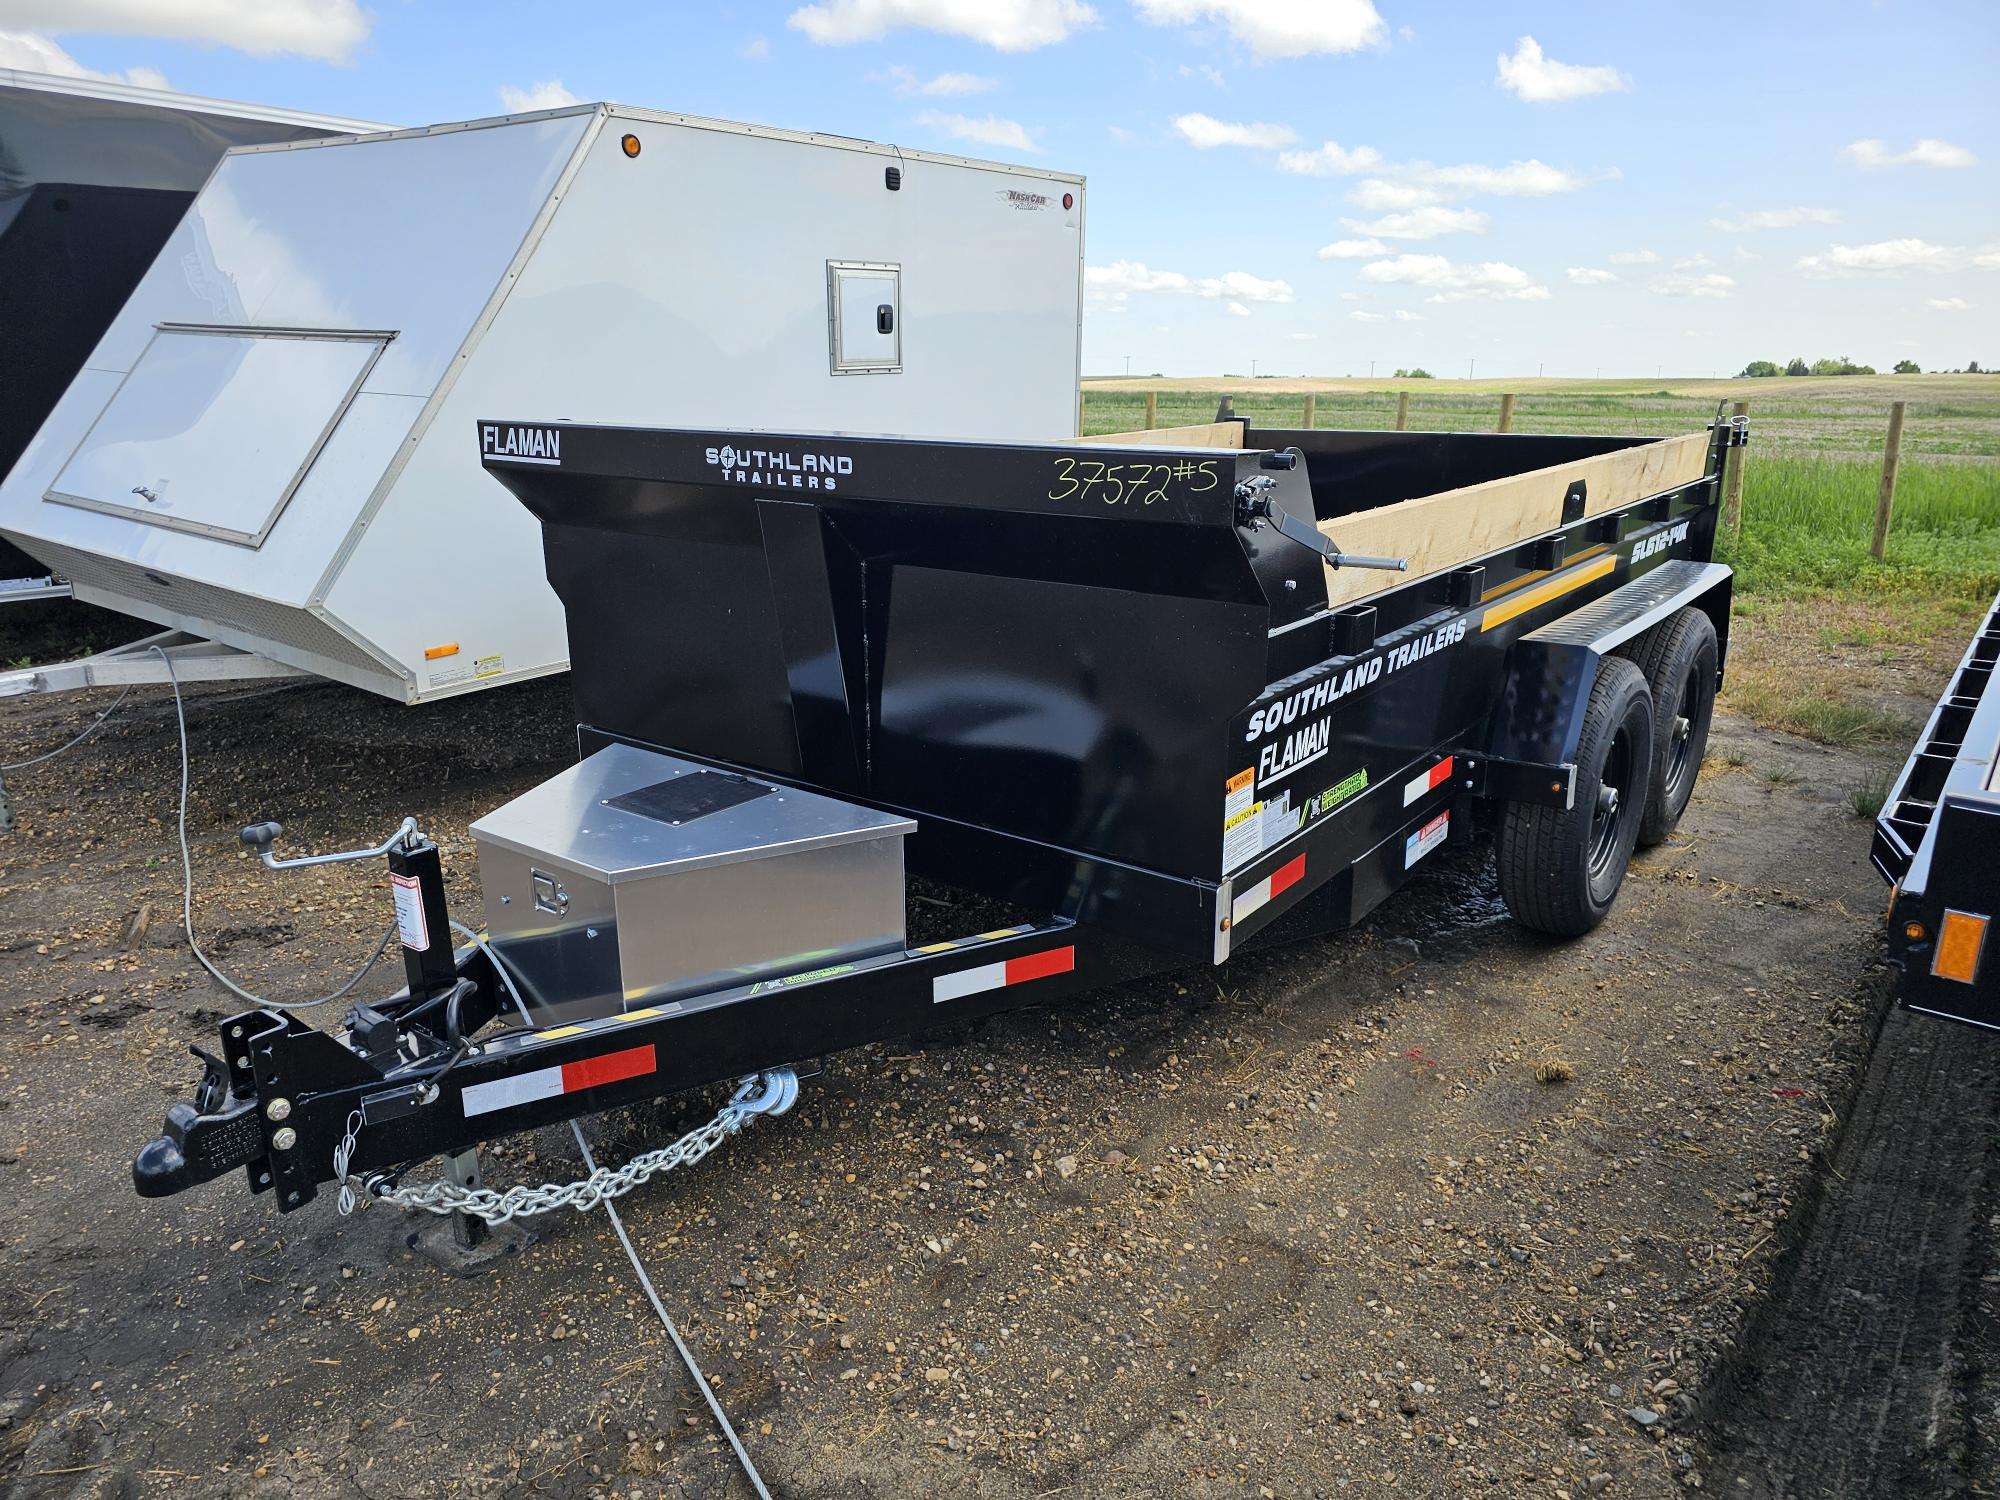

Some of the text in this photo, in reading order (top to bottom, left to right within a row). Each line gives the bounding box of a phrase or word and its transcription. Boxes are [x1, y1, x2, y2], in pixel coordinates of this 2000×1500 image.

[483, 426, 560, 458] FLAMAN
[705, 445, 853, 475] SOUTHLAND
[722, 470, 837, 490] TRAILERS
[1245, 618, 1467, 742] SOUTHLAND TRAILERS
[1258, 715, 1331, 781] FLAMAN
[1231, 809, 1252, 828] CAUTION
